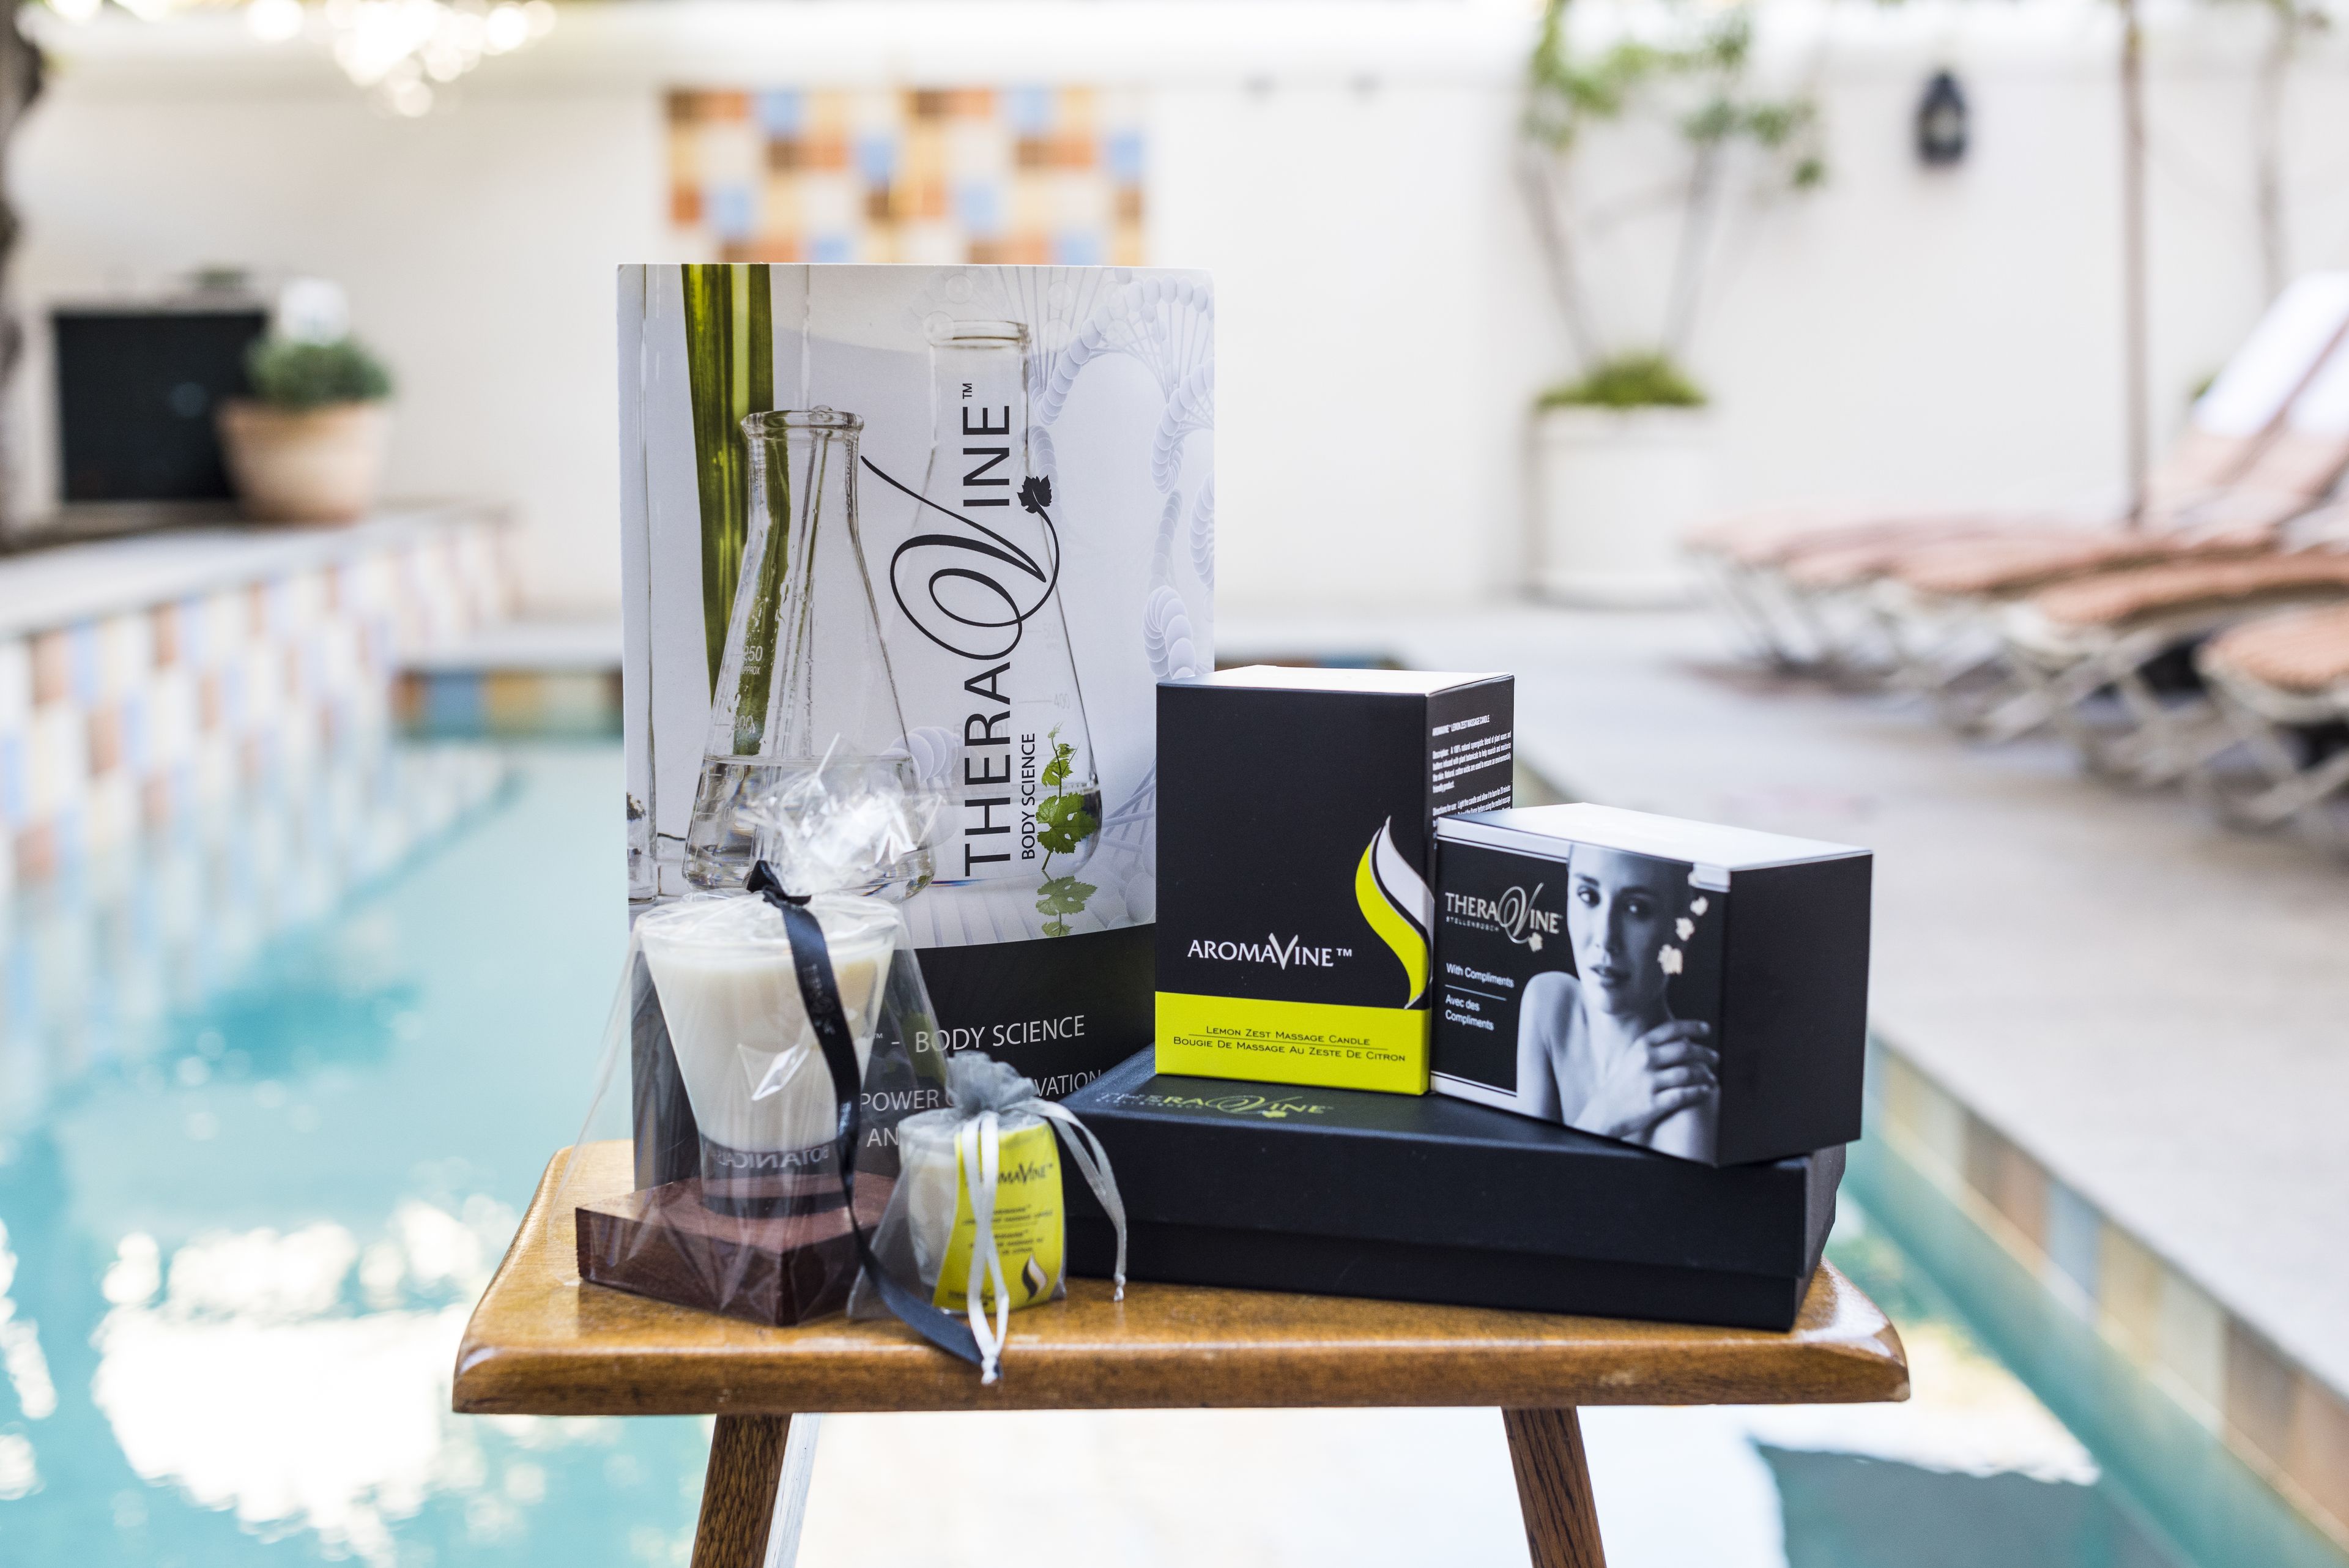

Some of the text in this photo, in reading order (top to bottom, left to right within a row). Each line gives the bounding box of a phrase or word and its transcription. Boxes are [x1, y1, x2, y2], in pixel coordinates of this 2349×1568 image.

[1021, 734, 1036, 860] BODY SCIENCE
[1446, 962, 1515, 989] With Compliments
[1445, 994, 1480, 1012] Avec des
[1445, 1009, 1495, 1031] Compliments
[916, 1026, 985, 1053] BODY
[992, 1015, 1085, 1047] SCIENCE
[1206, 1025, 1371, 1046] LEMON ZEST MASSAGE CANDLE
[1173, 1036, 1406, 1063] BOUGIE DE MASSAGE AU ZESTE DE CITRON
[860, 1089, 939, 1112] POWER
